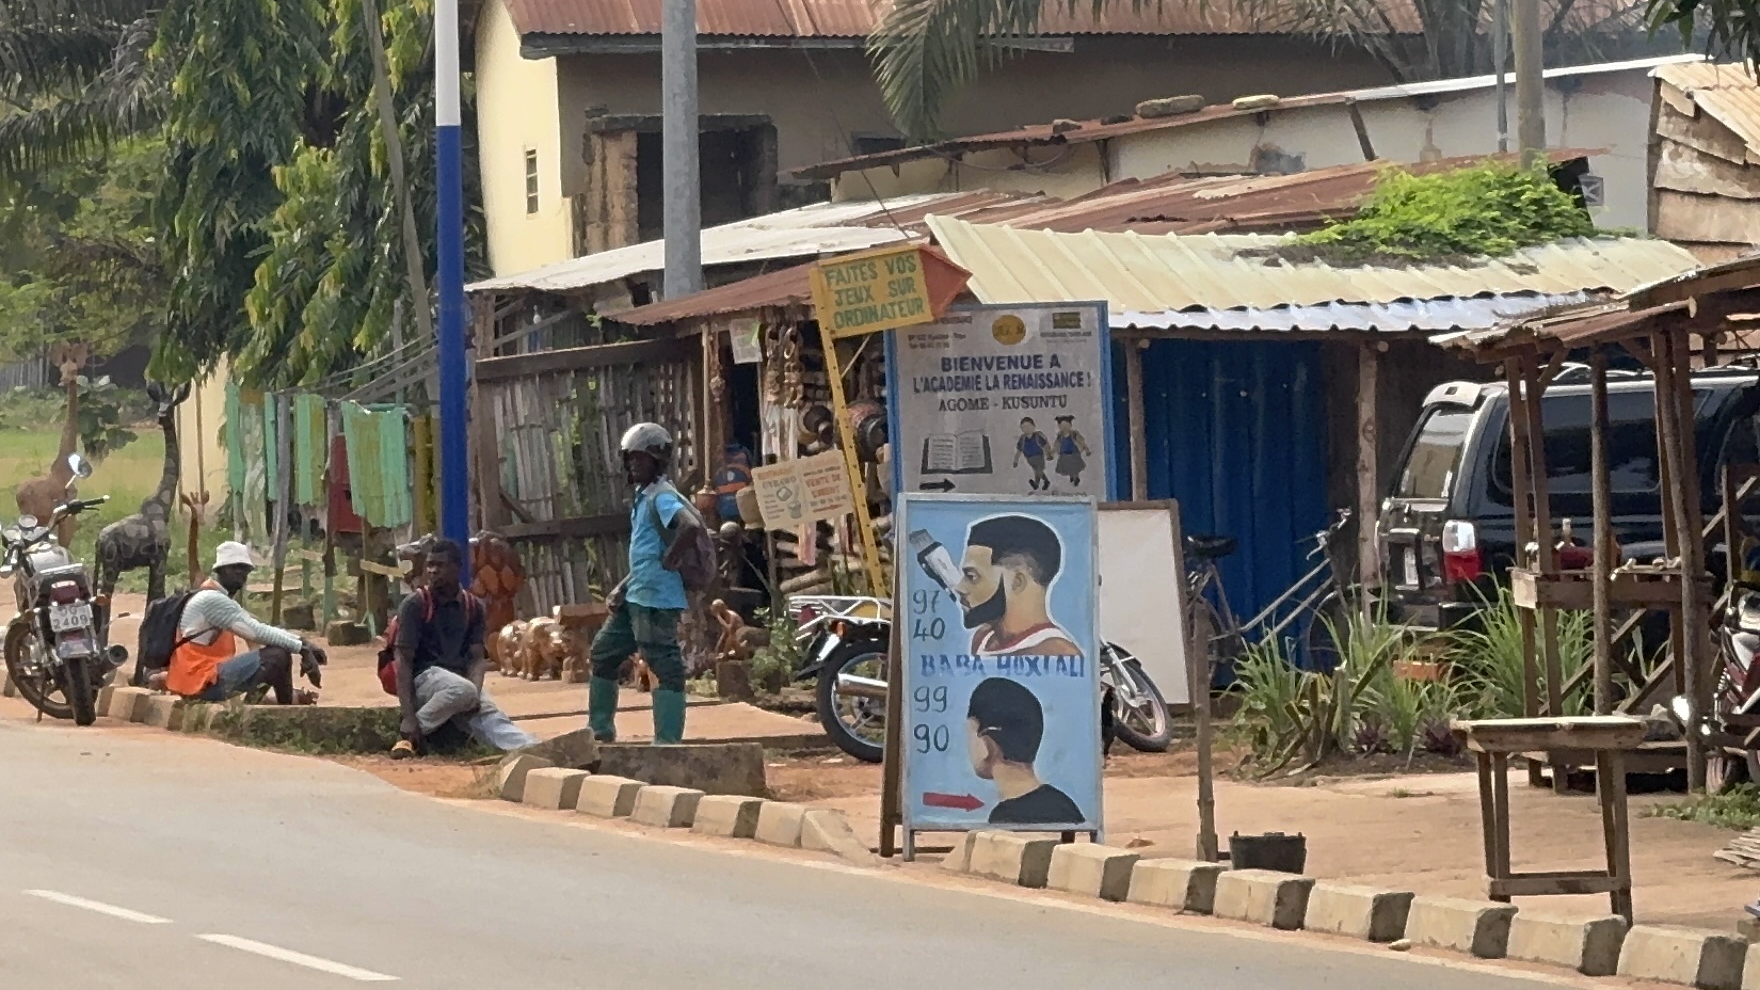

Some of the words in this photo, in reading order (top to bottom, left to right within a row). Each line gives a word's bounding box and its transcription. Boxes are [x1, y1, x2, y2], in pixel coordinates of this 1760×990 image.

[824, 261, 878, 288] FAITES
[884, 254, 917, 275] VOS
[834, 285, 875, 307] JEUX
[887, 276, 918, 298] SUR
[833, 297, 925, 329] ORDINATEUR
[941, 354, 1043, 372] BIENVENUE
[1049, 354, 1061, 369] A
[913, 374, 982, 394] L'ACADEMIE
[985, 374, 1000, 391] LA
[1003, 371, 1084, 390] RENAISSANCE
[939, 397, 990, 412] AGOME
[1002, 394, 1068, 410] KUSUNTU
[912, 589, 941, 615] 97
[913, 617, 946, 641] 40
[913, 685, 948, 713] 99
[913, 723, 950, 754] 90
